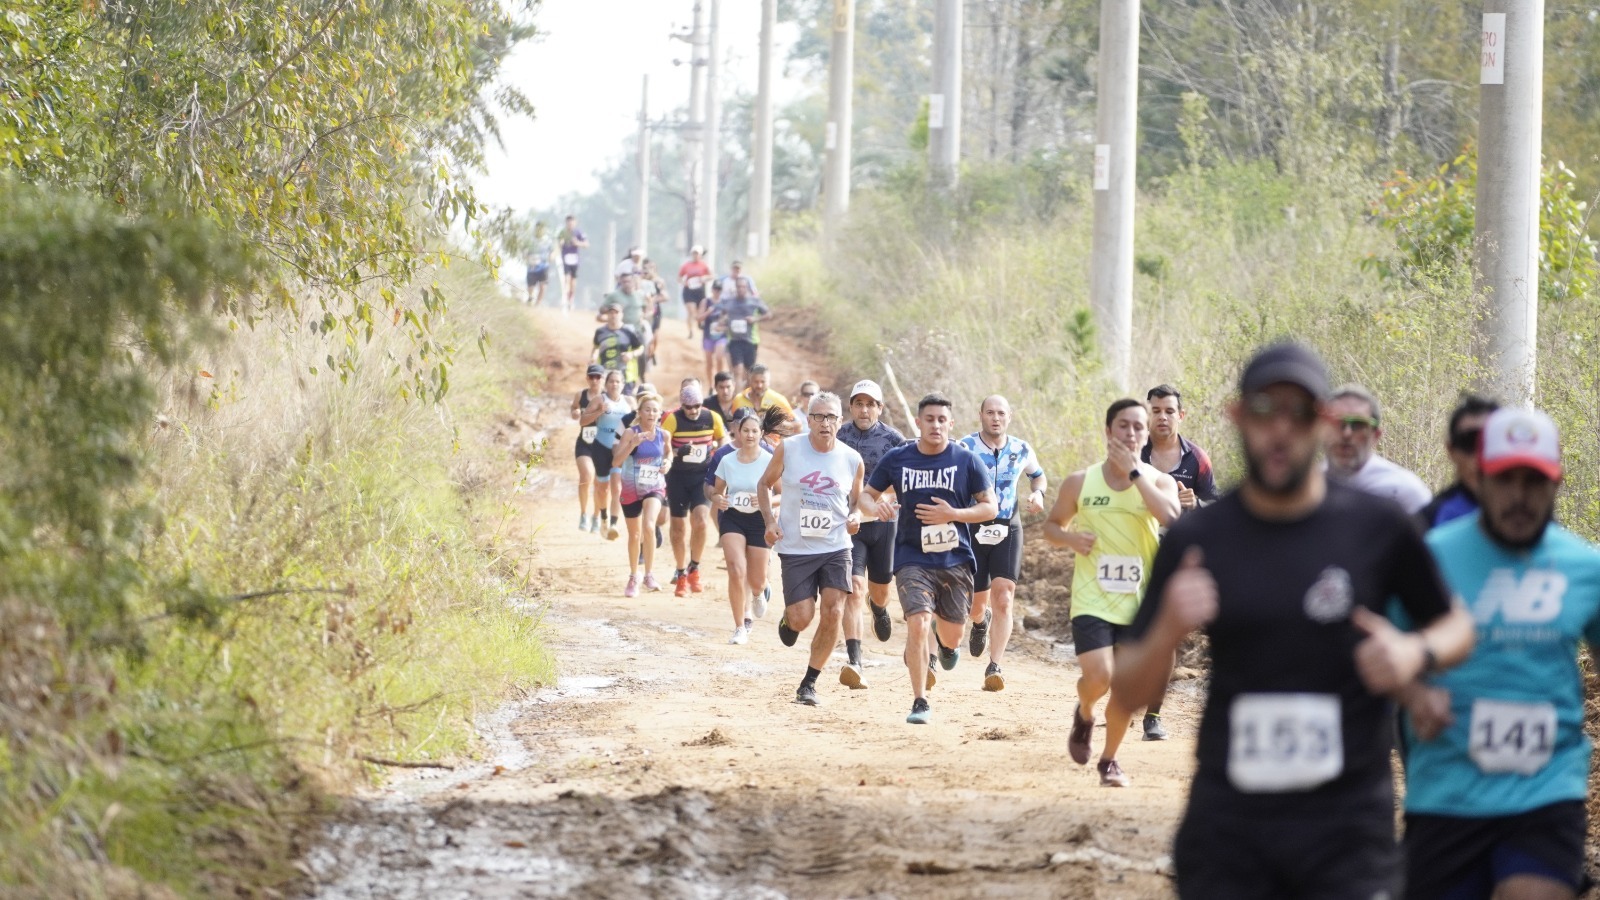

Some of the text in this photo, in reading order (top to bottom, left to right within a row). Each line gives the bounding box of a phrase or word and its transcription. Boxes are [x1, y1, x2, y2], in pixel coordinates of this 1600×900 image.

[639, 469, 659, 480] 123
[901, 465, 958, 494] EVERLAST
[800, 515, 831, 530] 102
[923, 529, 958, 546] 112
[982, 529, 1002, 539] 29
[1098, 563, 1141, 583] 113
[1470, 567, 1569, 624] NB
[1475, 715, 1551, 750] 141
